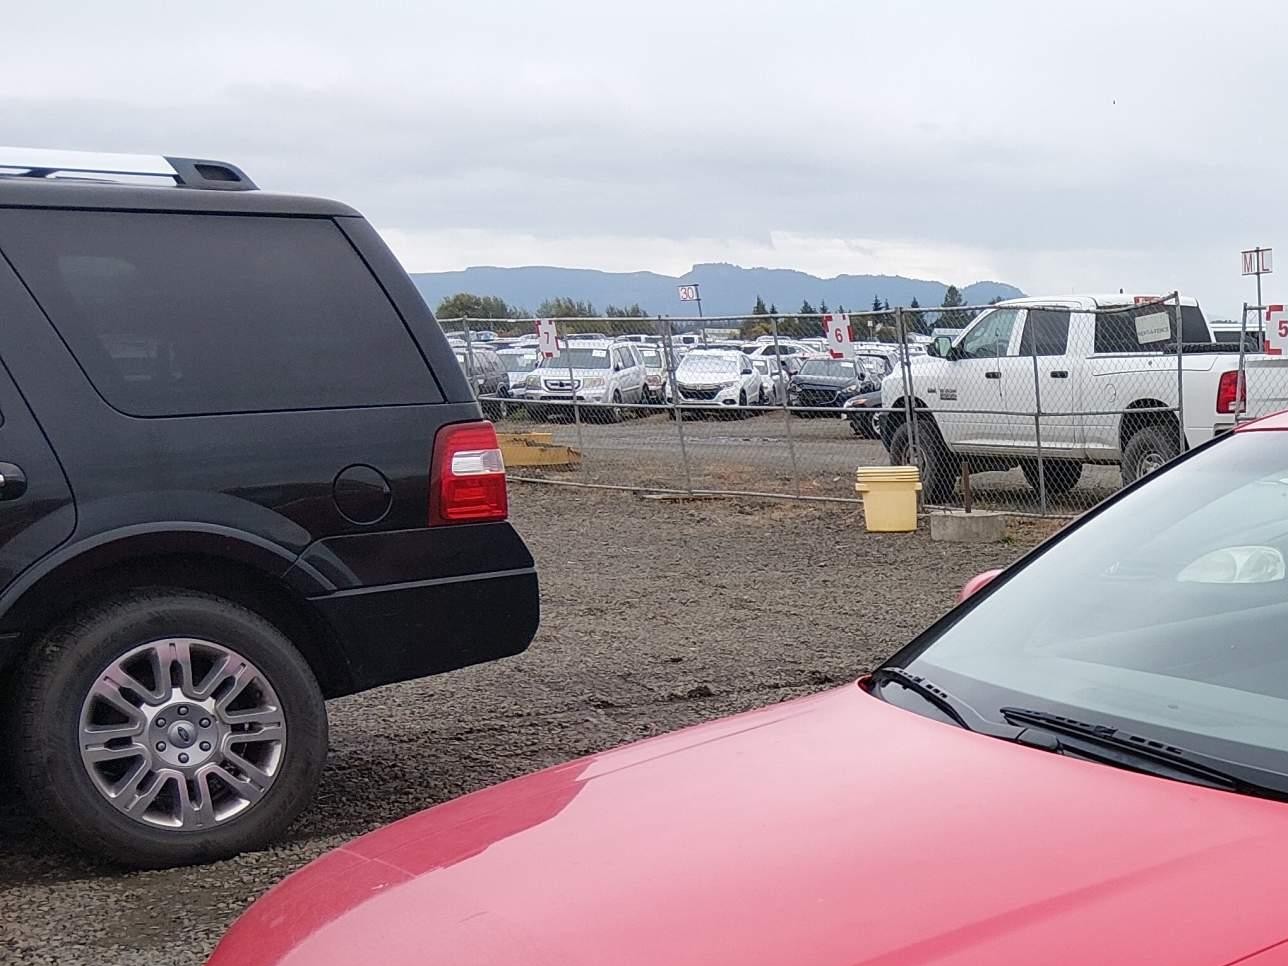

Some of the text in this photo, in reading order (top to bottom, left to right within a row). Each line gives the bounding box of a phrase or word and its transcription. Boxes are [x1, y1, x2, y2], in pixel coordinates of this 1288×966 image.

[1243, 251, 1270, 273] M L
[680, 286, 694, 300] 30
[834, 327, 844, 344] 6
[1278, 320, 1288, 338] 5
[543, 331, 550, 345] 7
